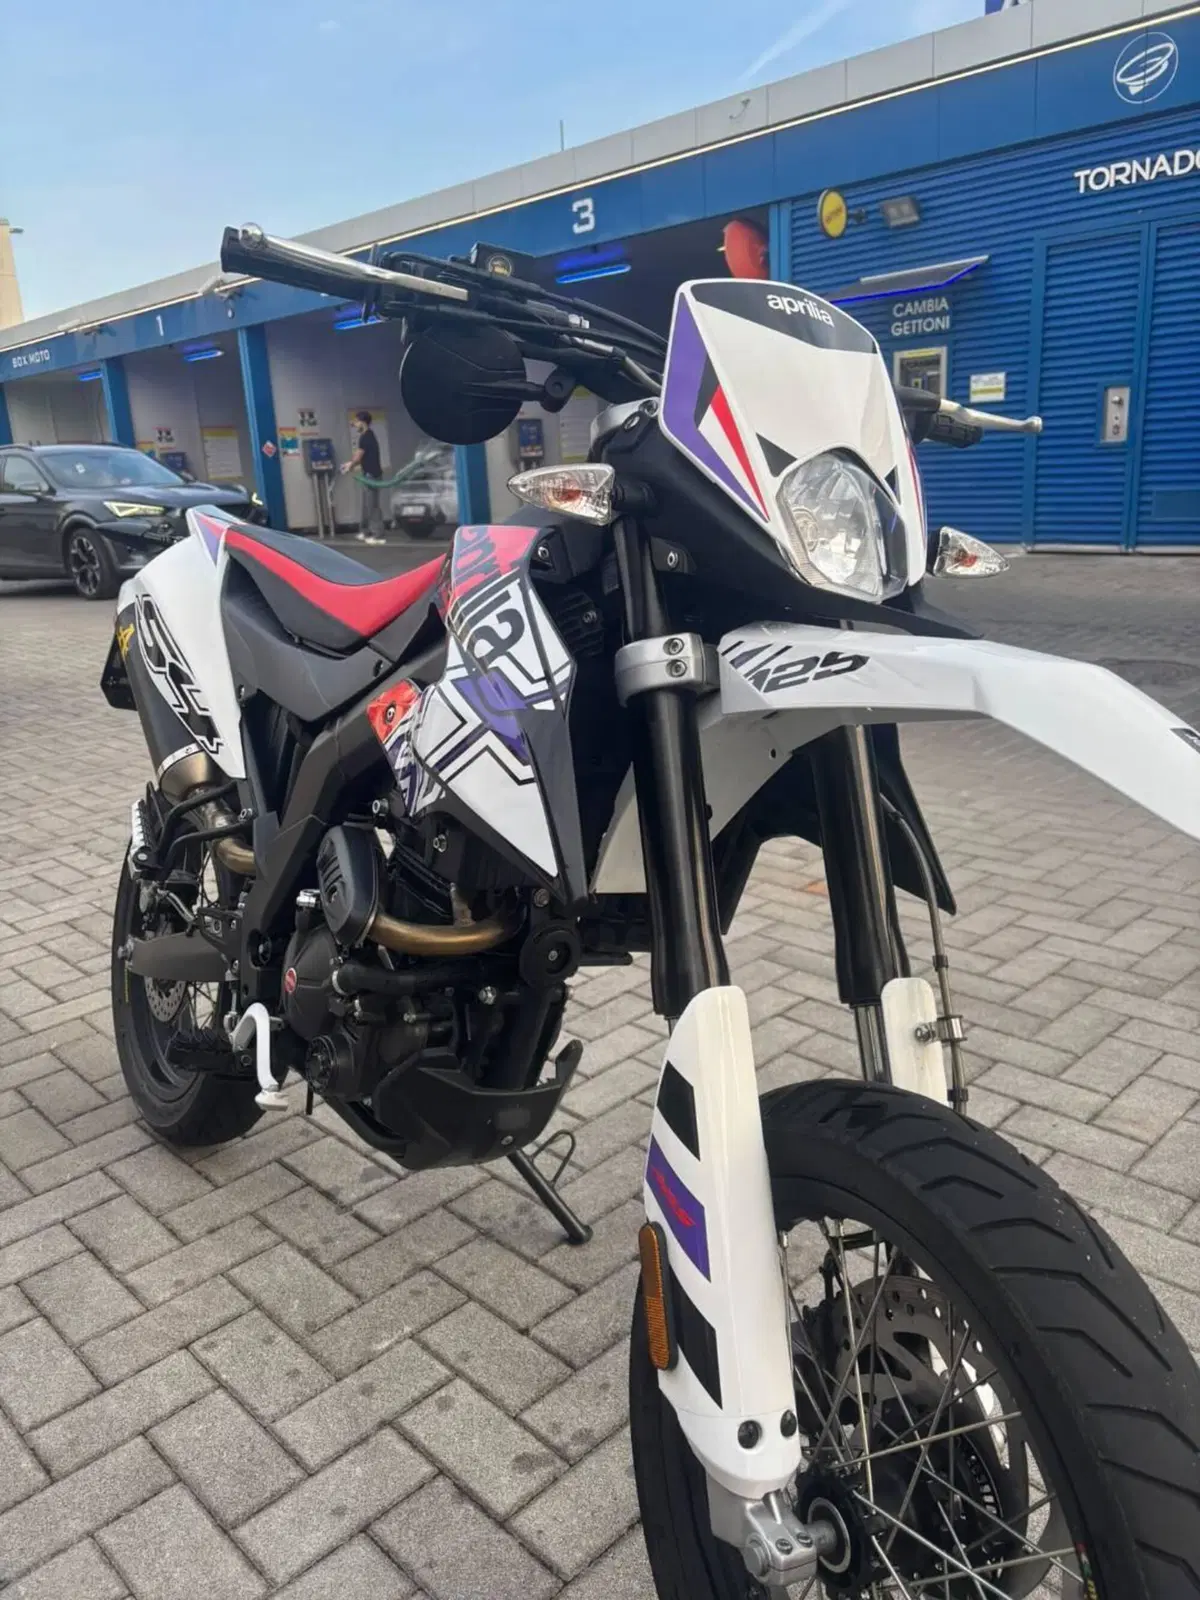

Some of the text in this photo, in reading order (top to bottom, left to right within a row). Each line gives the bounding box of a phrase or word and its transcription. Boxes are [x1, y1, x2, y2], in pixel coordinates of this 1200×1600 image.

[1073, 149, 1200, 194] TORNAD
[572, 197, 595, 234] 3
[766, 294, 835, 328] aprilia
[892, 296, 949, 318] CAMBIA
[155, 314, 164, 337] 1
[891, 315, 951, 336] GETTONI
[12, 349, 50, 369] BOX MOTO
[748, 650, 870, 693] 125
